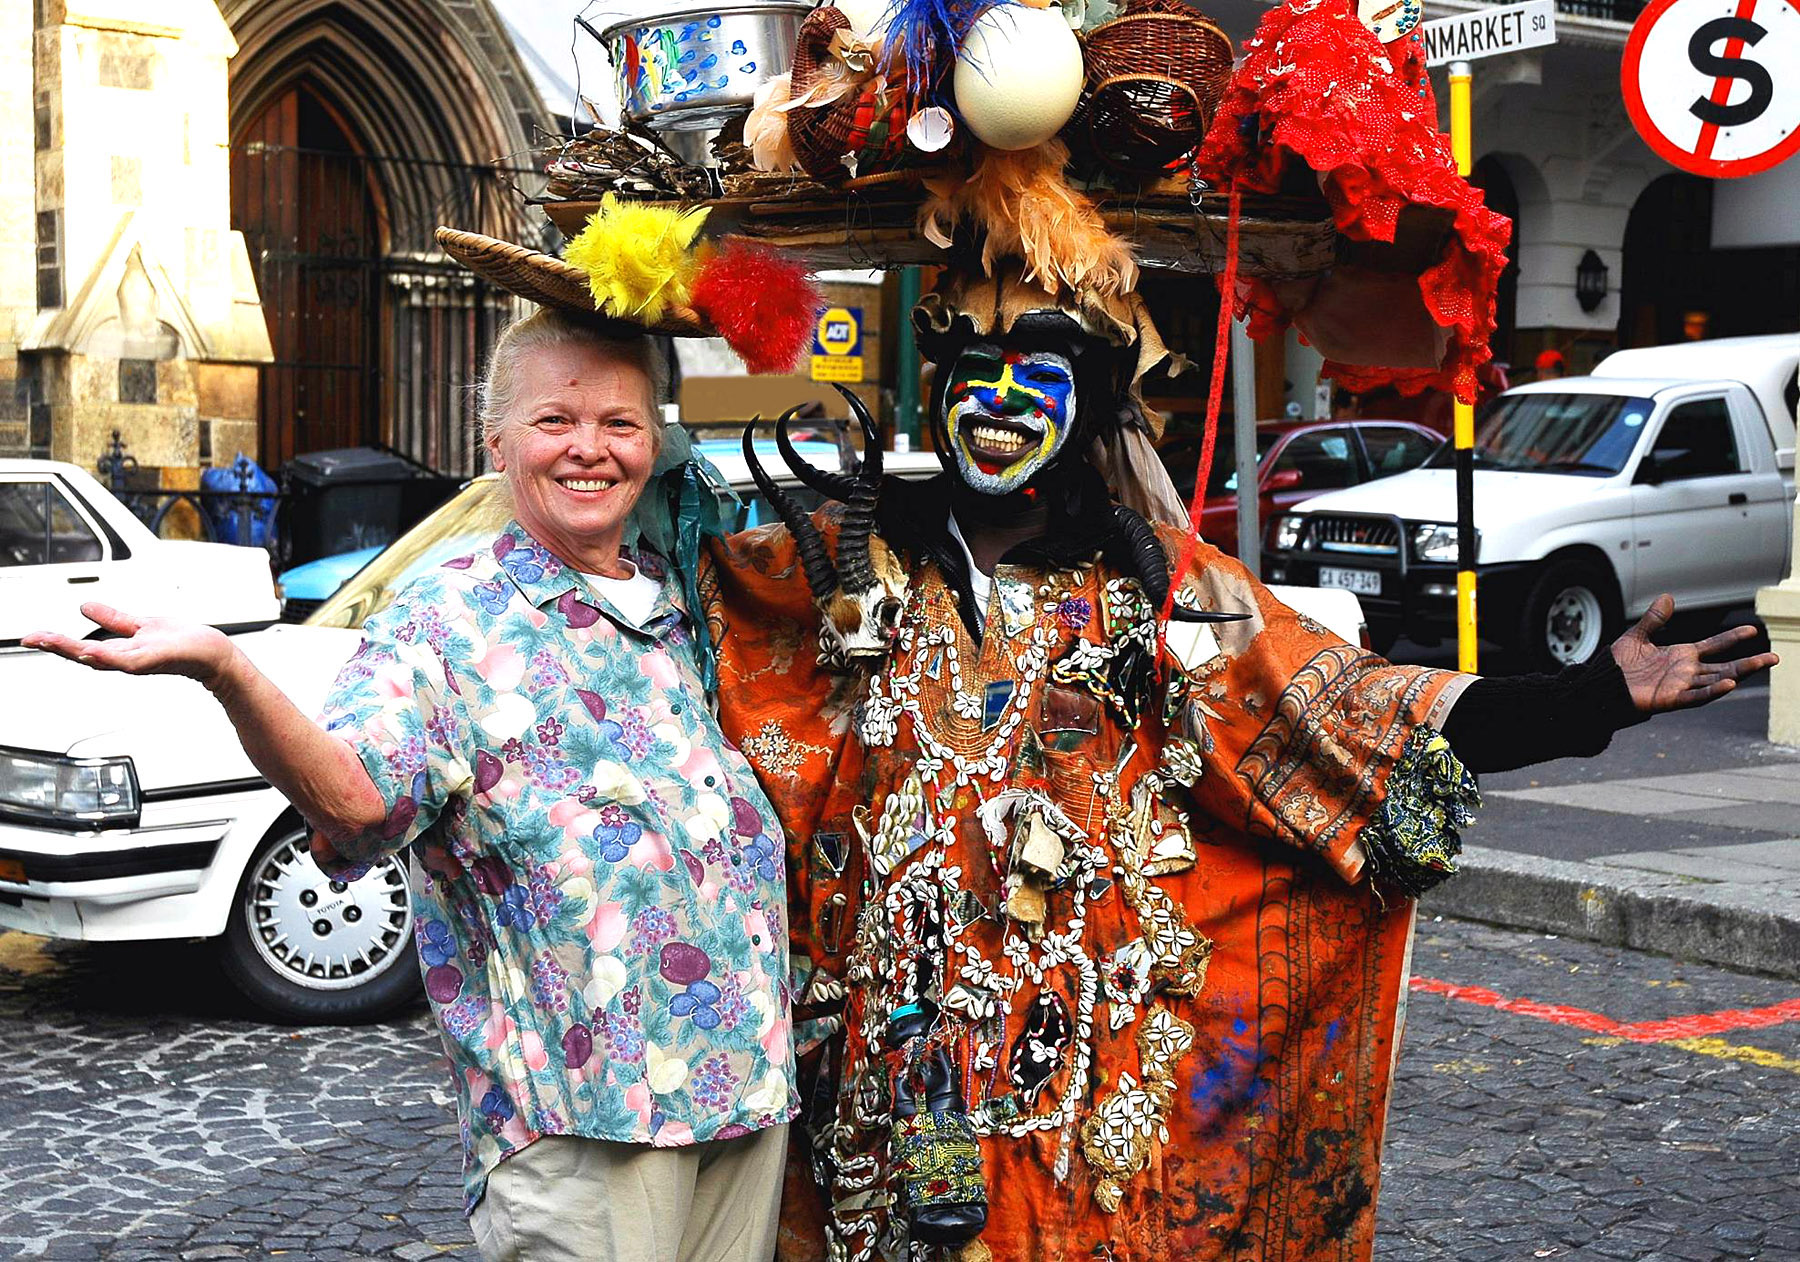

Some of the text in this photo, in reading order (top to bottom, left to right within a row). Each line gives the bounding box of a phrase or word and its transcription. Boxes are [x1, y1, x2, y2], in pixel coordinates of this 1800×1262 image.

[1532, 14, 1546, 32] SQ
[1688, 16, 1774, 127] S
[826, 323, 849, 340] ADT
[317, 899, 345, 915] TOYOTA
